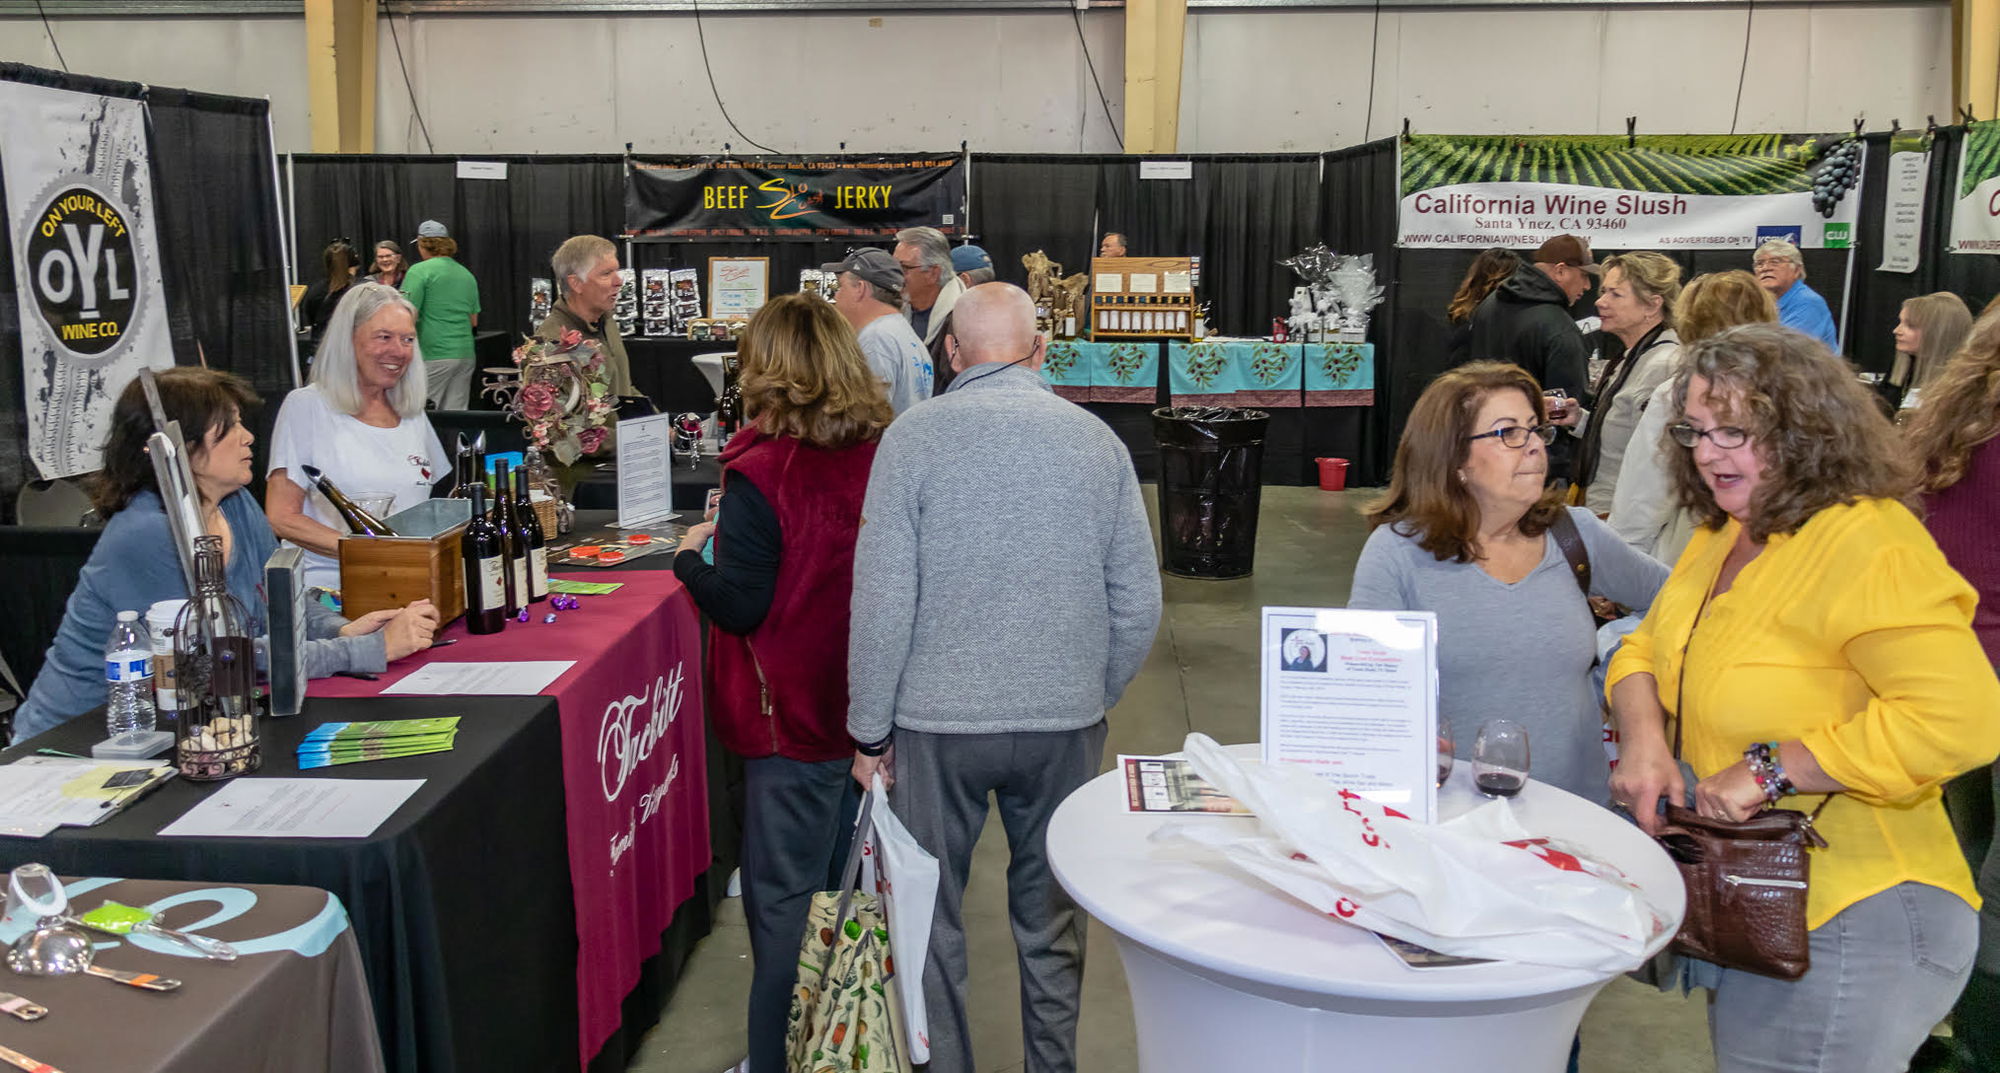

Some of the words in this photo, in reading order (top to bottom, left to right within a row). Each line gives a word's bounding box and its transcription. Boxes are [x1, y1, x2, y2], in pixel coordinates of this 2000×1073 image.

[703, 186, 748, 209] BEEF
[834, 185, 893, 209] JERKY
[1415, 193, 1535, 215] California
[1545, 195, 1607, 215] Wine
[1616, 194, 1687, 215] Slush
[41, 208, 63, 237] ON
[58, 194, 96, 215] YOUR
[96, 203, 126, 237] LEFT
[1475, 217, 1513, 230] Santa
[1559, 217, 1581, 230] CA
[1586, 217, 1627, 230] 93460
[1658, 236, 1671, 244] AS
[1672, 236, 1725, 244] ADVERTISED
[1726, 236, 1739, 244] ON
[1825, 231, 1849, 240] CW
[38, 223, 129, 309] OYL
[62, 322, 98, 340] WINE
[98, 321, 121, 337] CO.
